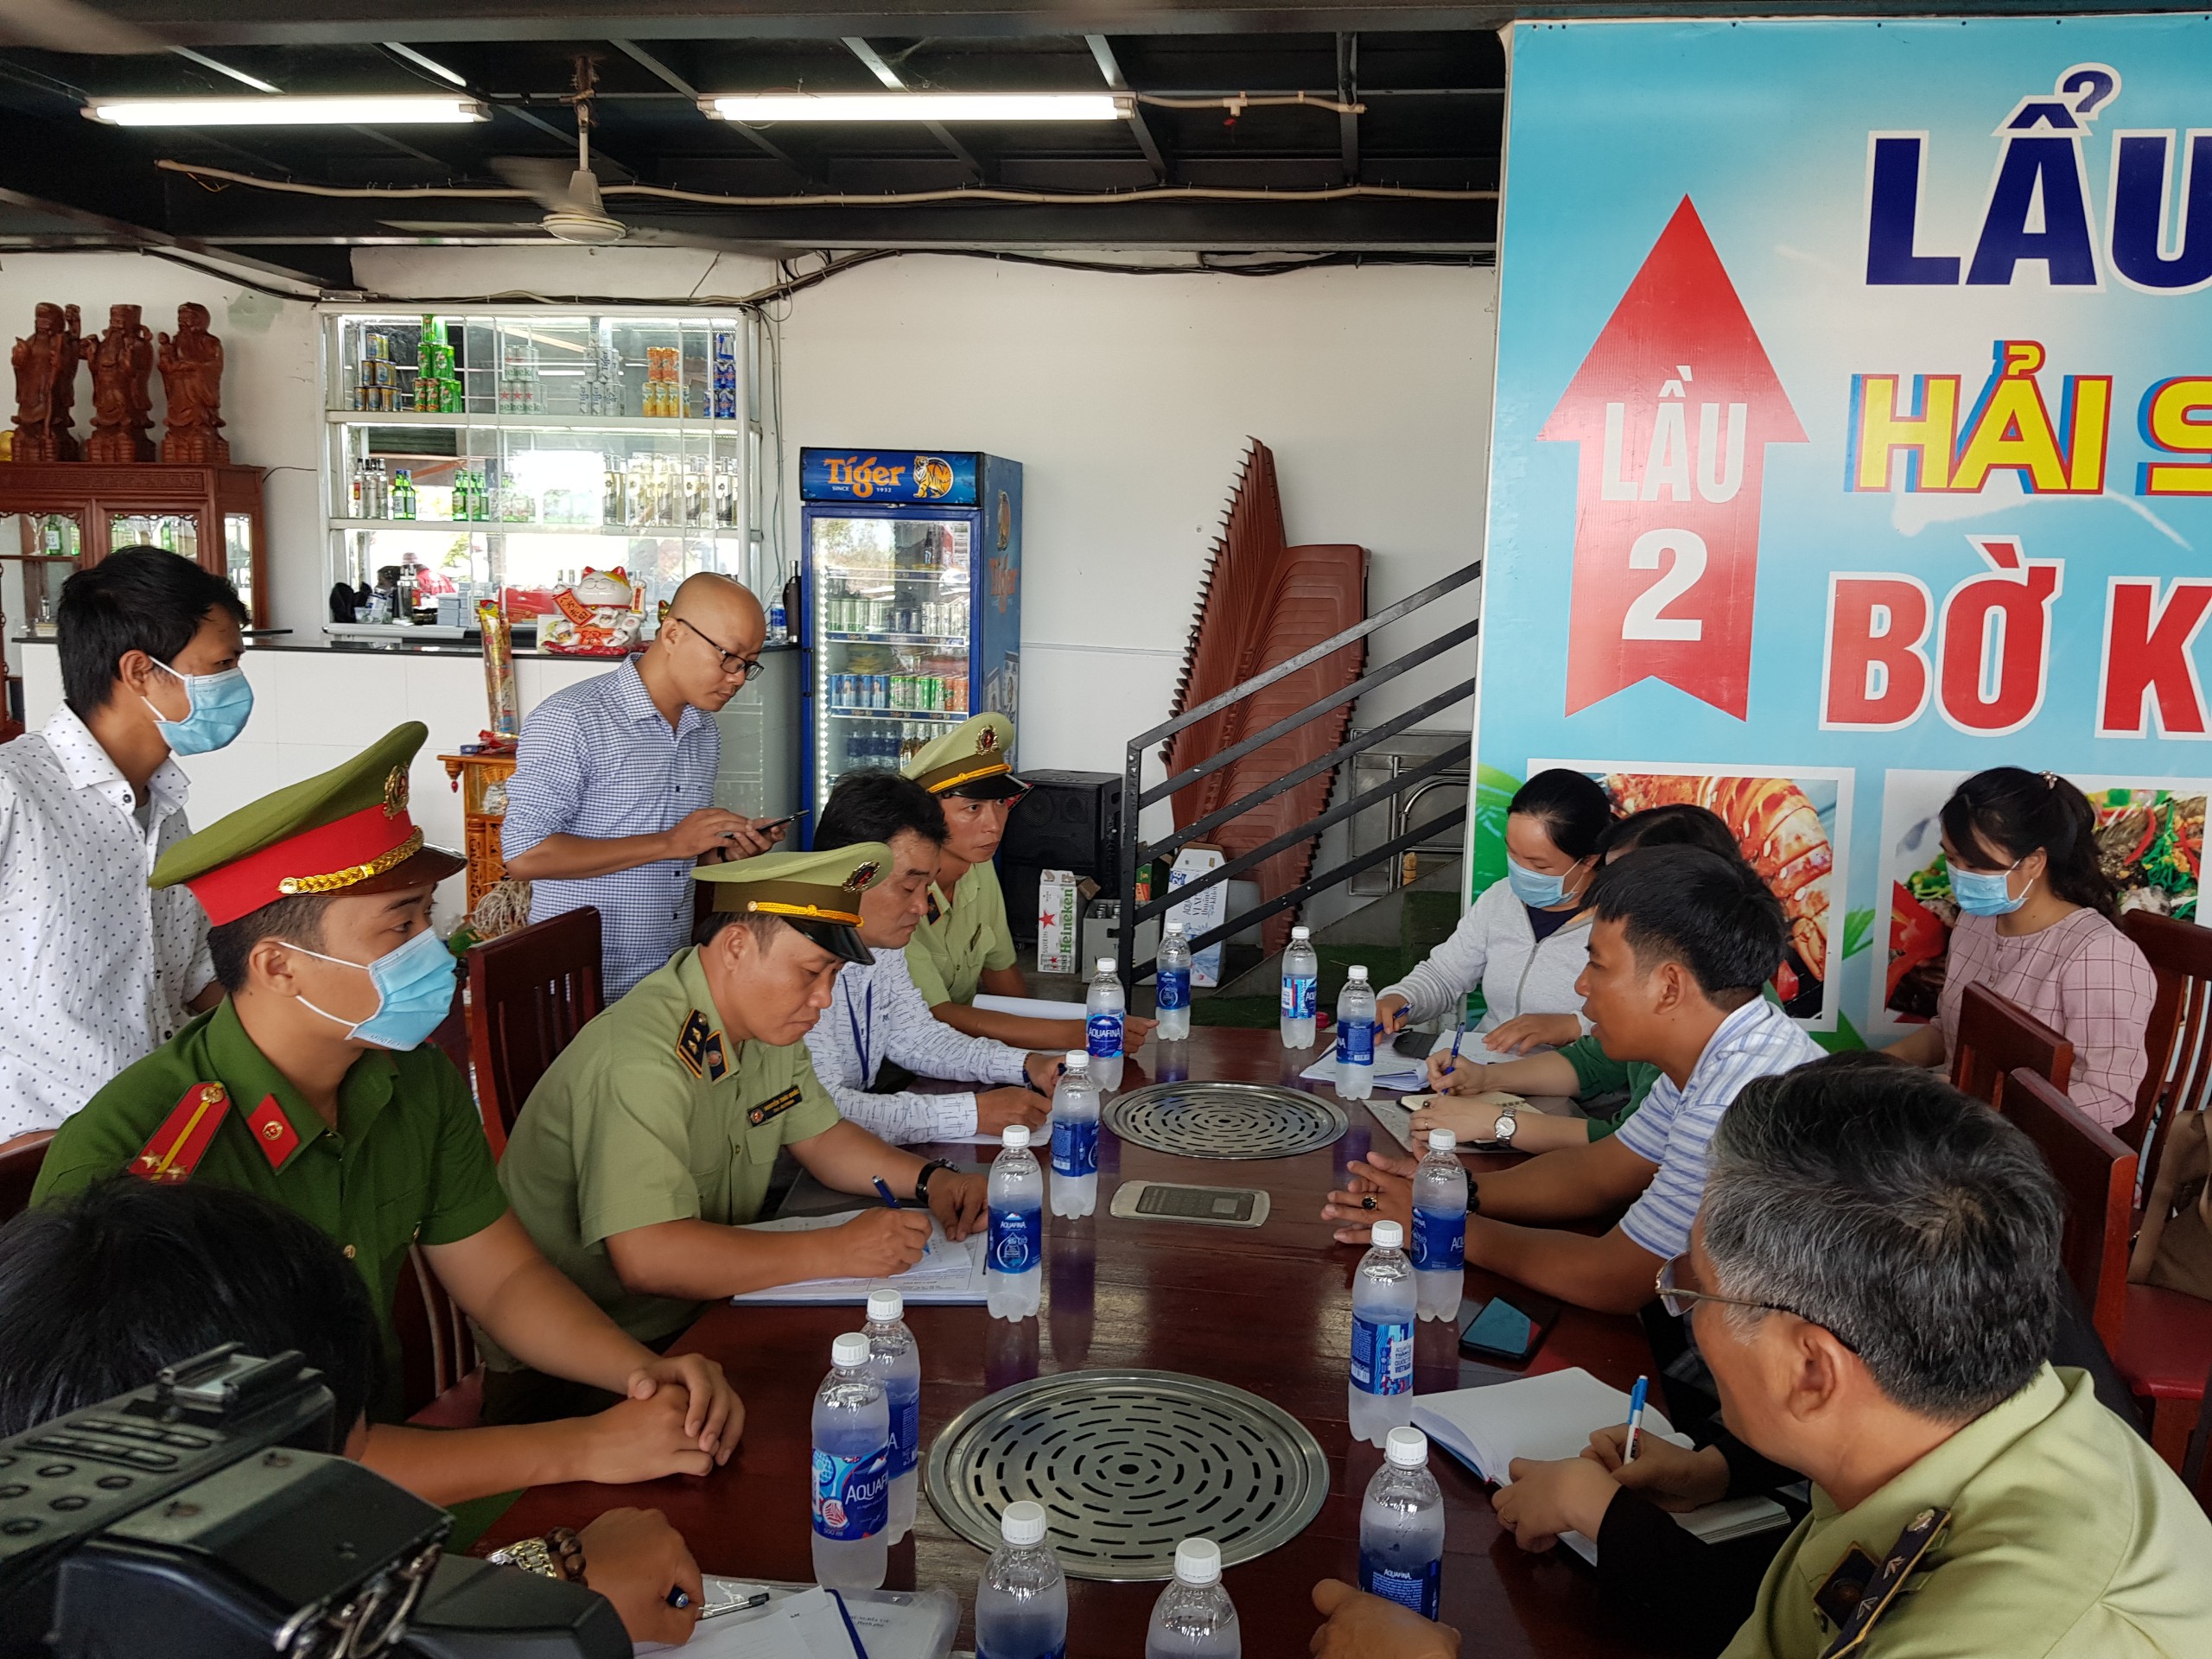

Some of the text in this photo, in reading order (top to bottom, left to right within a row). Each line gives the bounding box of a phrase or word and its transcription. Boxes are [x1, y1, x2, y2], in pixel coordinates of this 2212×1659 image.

[1862, 63, 2212, 294] LẨU
[1600, 365, 1746, 504] LẦU
[1844, 340, 2113, 496] HẢI
[824, 456, 906, 498] Tiger
[1622, 529, 1708, 641] 2
[1820, 535, 2064, 738] BỜ
[1172, 870, 1183, 885] 28
[1059, 888, 1073, 954] Heineken
[1088, 1027, 1121, 1039] AQUAFINA
[845, 1471, 888, 1504] AQUAF
[1383, 1568, 1412, 1580] AQUAFINA
